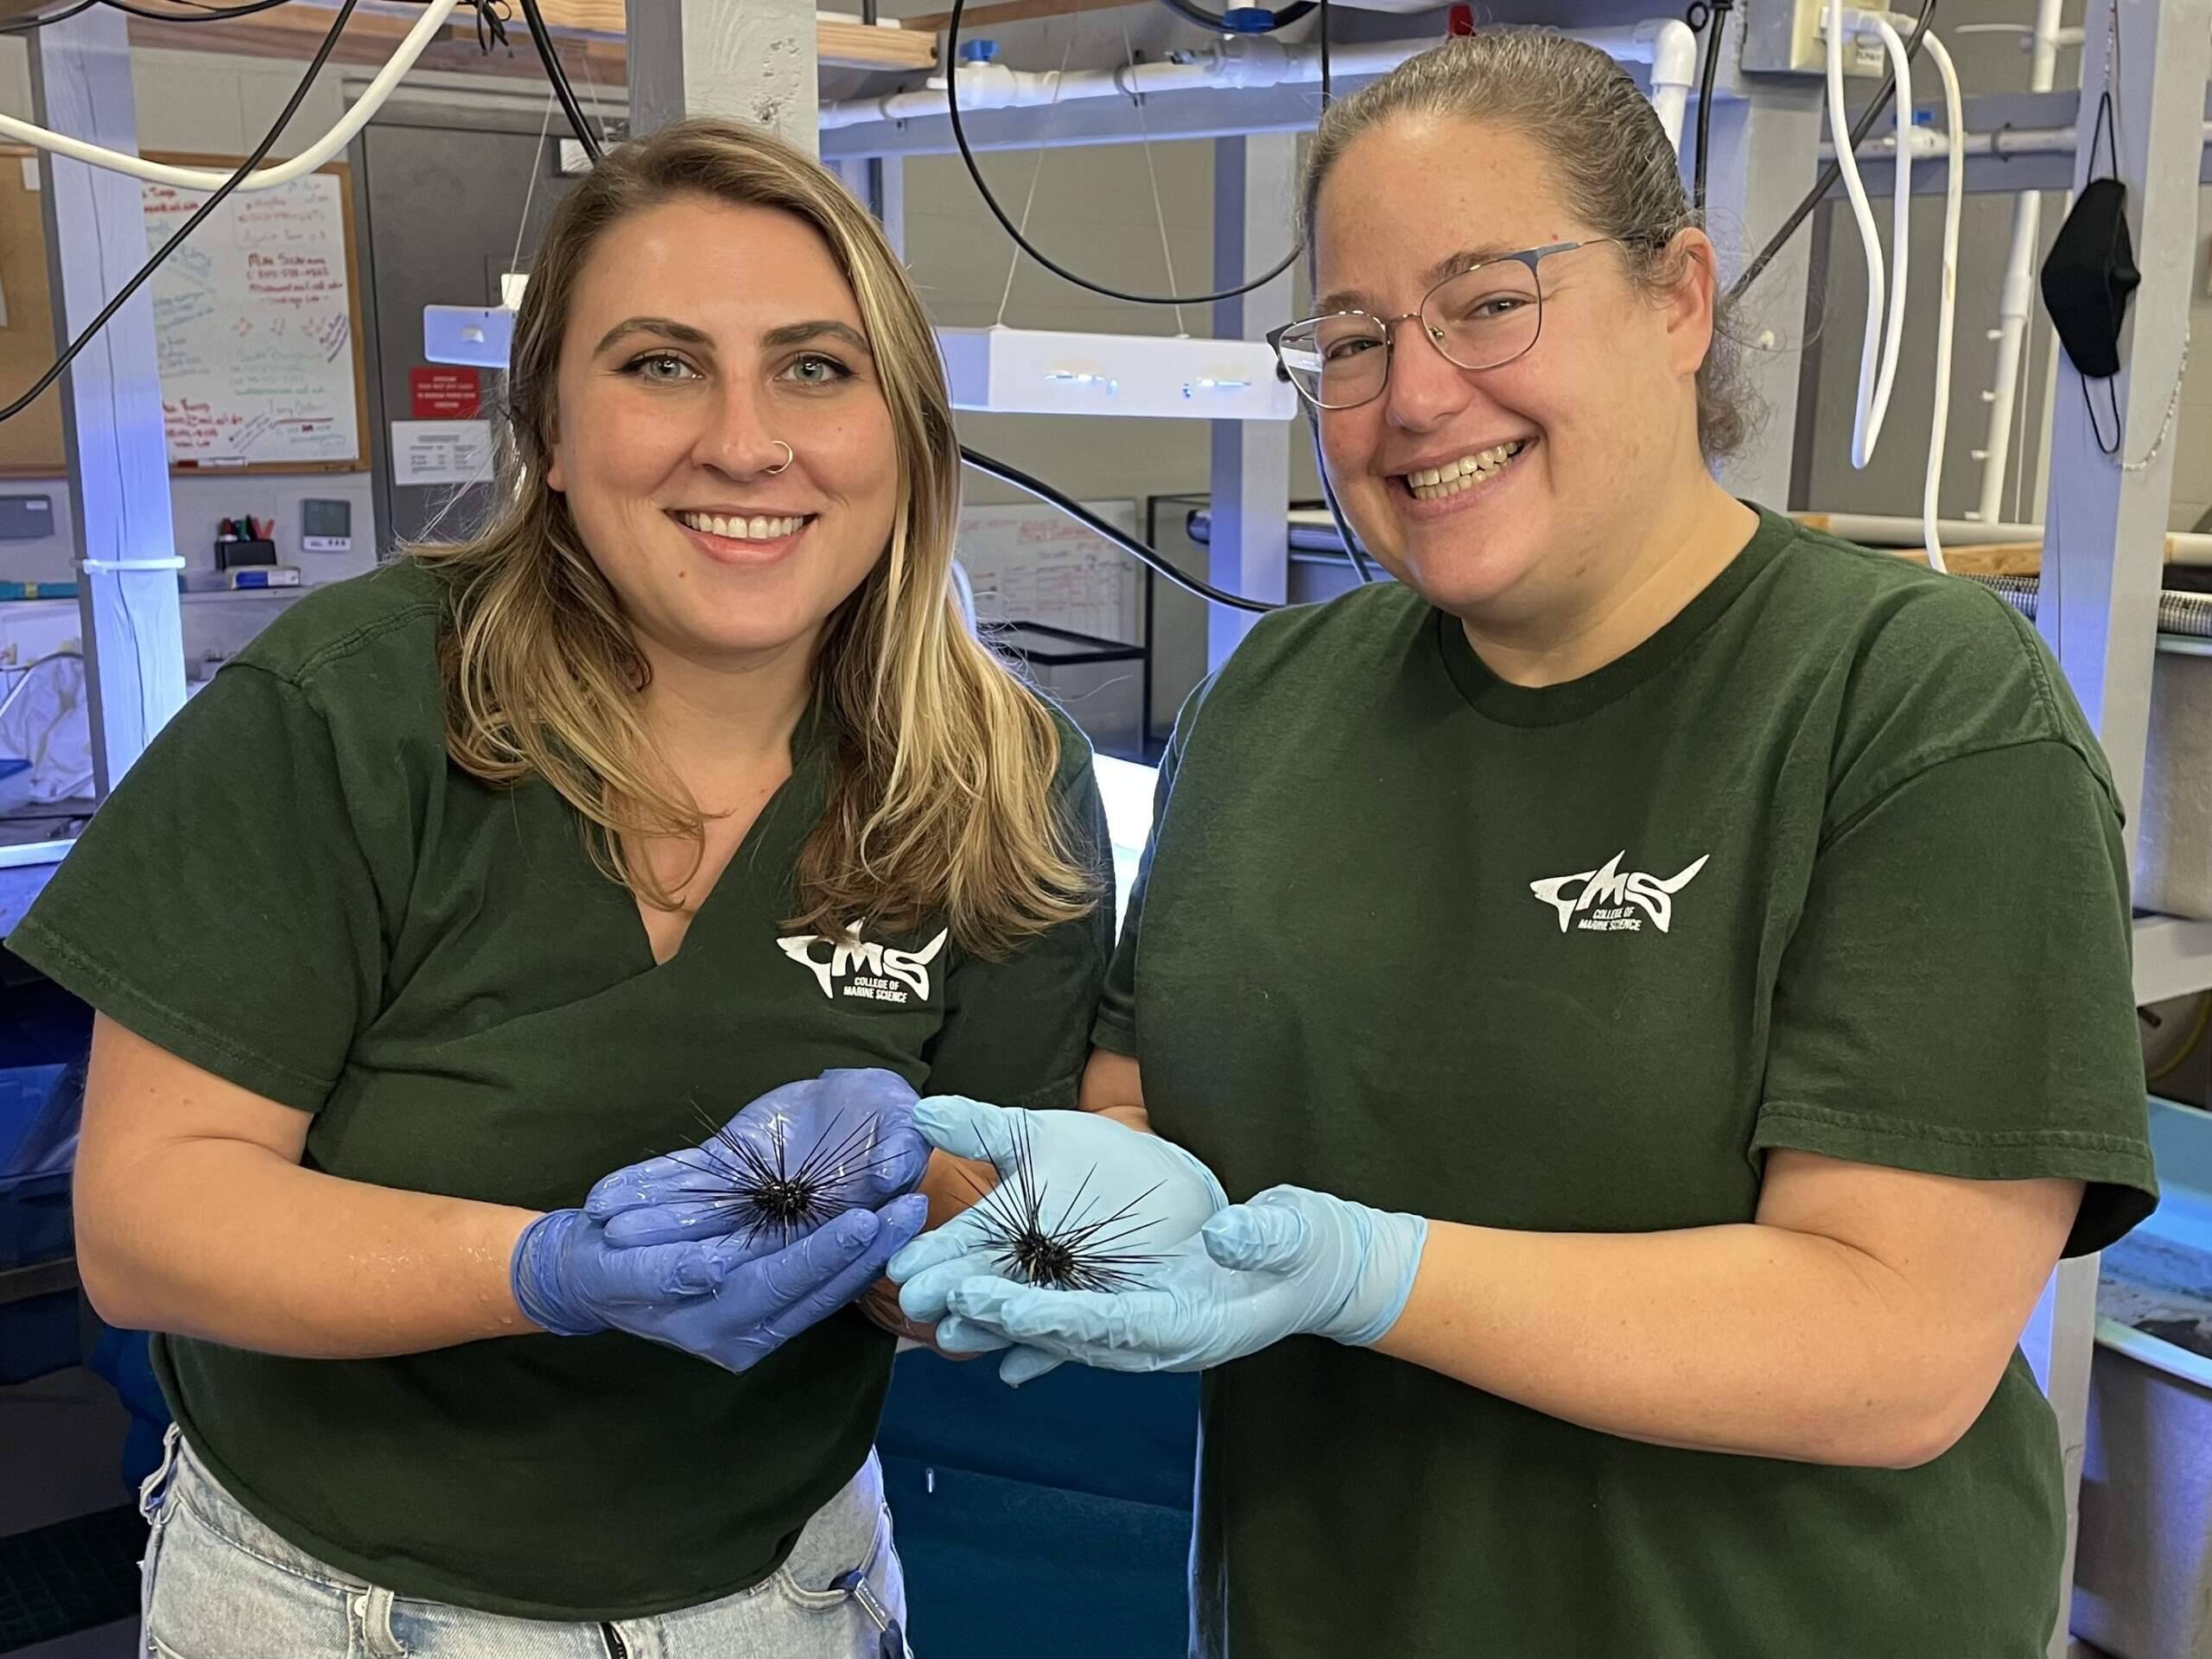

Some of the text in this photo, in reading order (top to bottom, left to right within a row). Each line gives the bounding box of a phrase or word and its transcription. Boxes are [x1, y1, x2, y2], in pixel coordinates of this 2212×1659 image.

[1529, 850, 1710, 933] CMS
[1592, 906, 1635, 919] COLLEGE OF
[1578, 918, 1642, 931] MARINE SCIENCE
[776, 917, 949, 1001] CMS
[855, 976, 899, 990] COLLEGE OF
[843, 986, 907, 1003] MARINE SCIENCE
